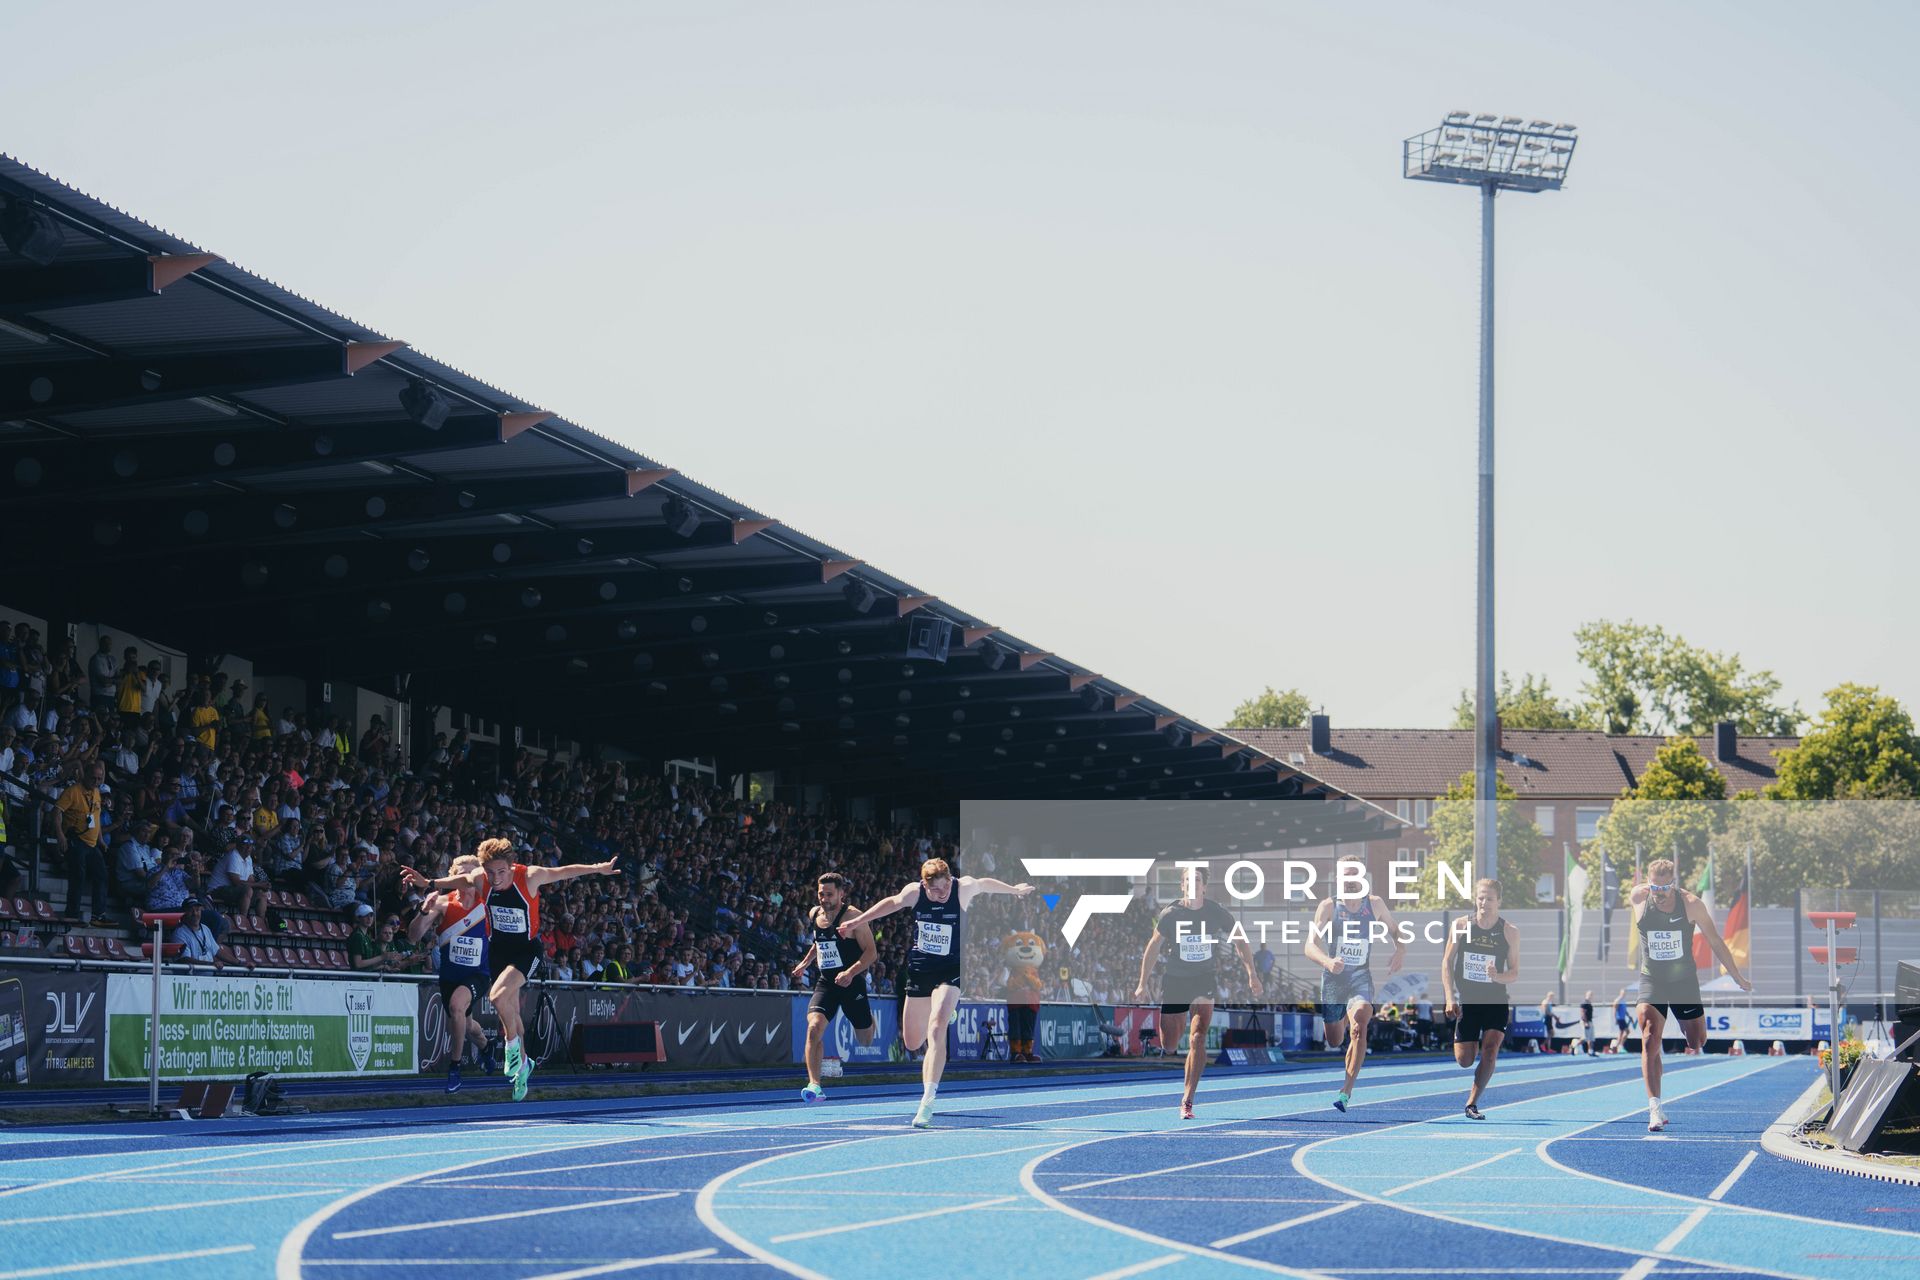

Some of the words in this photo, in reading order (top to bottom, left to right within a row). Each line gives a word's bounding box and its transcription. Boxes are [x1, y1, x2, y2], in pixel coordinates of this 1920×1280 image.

[923, 923, 942, 931] GLS
[457, 937, 474, 945] GLS
[1649, 940, 1681, 950] HELCELET
[451, 946, 479, 957] ATTWELL
[1340, 946, 1364, 957] KAUL
[1470, 954, 1486, 962] GLS
[172, 982, 197, 1010] Wir
[200, 984, 250, 1011] machen
[254, 984, 273, 1011] Sie
[277, 985, 293, 1011] fit!
[45, 992, 96, 1034] DLV
[589, 999, 616, 1019] LifeStyle
[1776, 1015, 1800, 1023] PLAN
[144, 1018, 190, 1041] Fness-
[192, 1019, 212, 1041] und
[214, 1018, 315, 1041] Gesundheitszentren
[374, 1023, 410, 1035] turnverein
[1040, 1020, 1057, 1047] WGV
[1071, 1020, 1086, 1046] WGV
[374, 1041, 404, 1055] ratingen
[158, 1047, 207, 1074] Ratingen
[210, 1045, 236, 1069] Mitte
[238, 1045, 246, 1068] &
[248, 1045, 294, 1072] Ratingen
[296, 1045, 313, 1066] Ost
